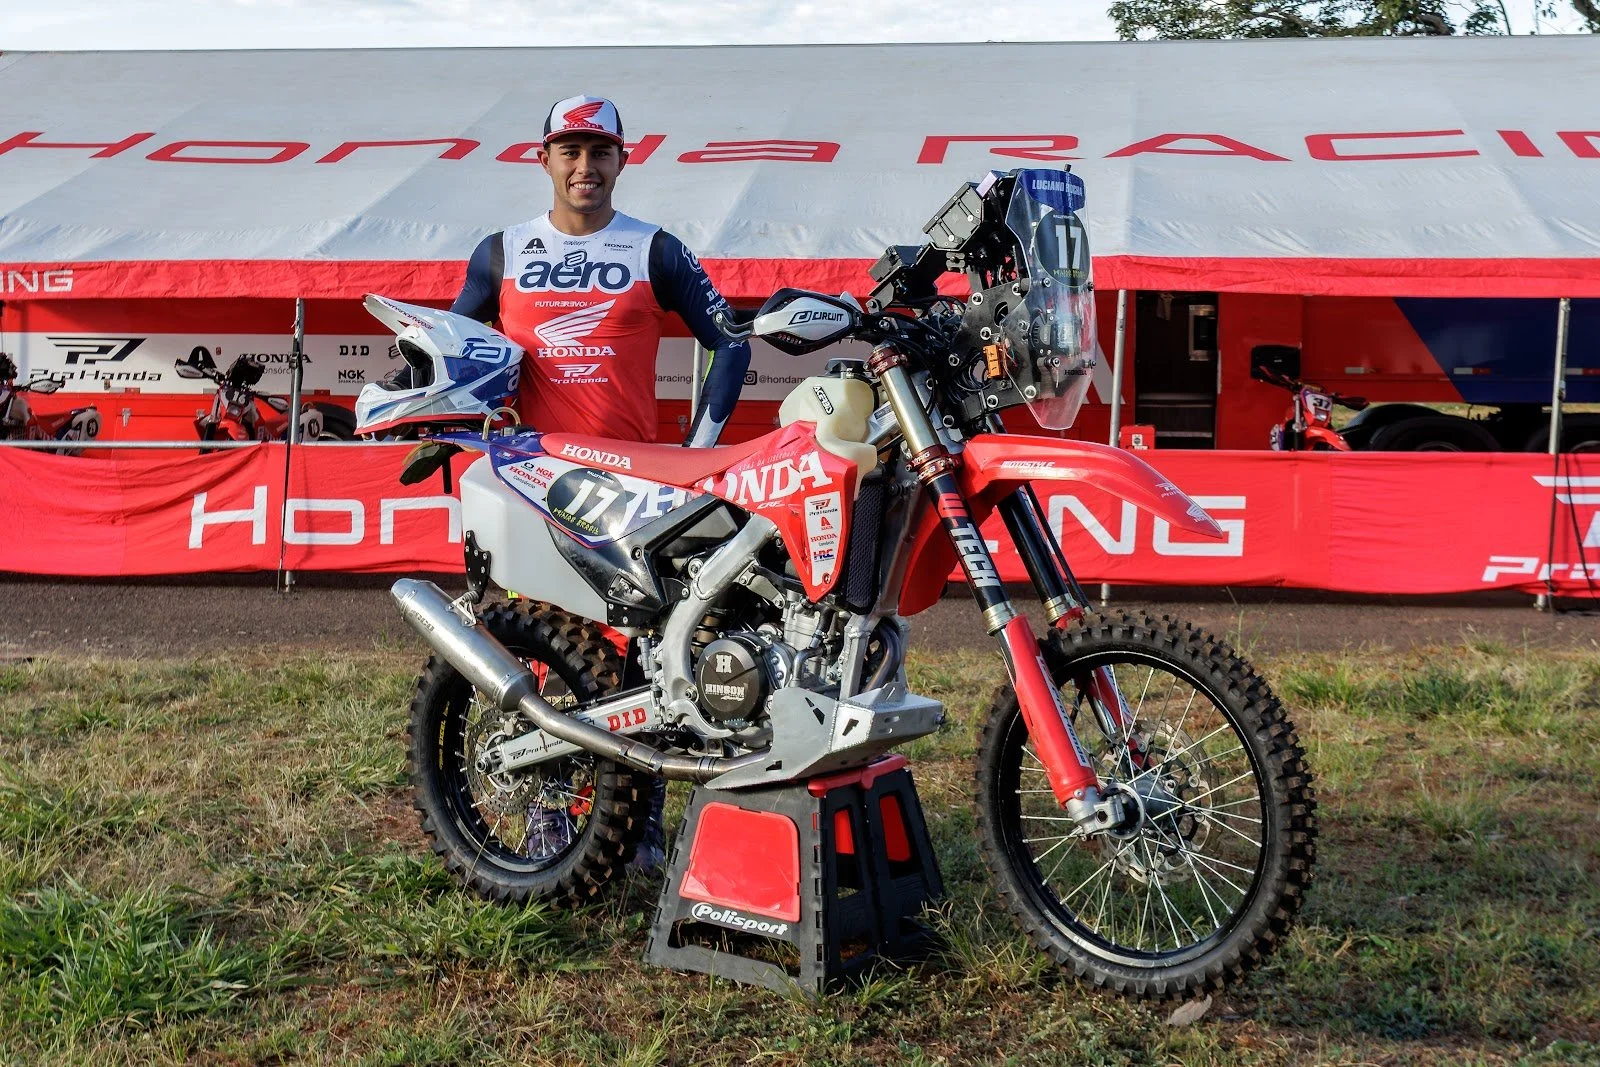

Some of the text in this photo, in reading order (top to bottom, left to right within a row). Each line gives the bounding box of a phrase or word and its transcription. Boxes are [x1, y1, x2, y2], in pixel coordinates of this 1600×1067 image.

[1032, 180, 1064, 191] LUCIANO
[1055, 225, 1082, 268] 17
[519, 261, 631, 289] aero
[811, 312, 845, 322] CIRCUIT
[240, 353, 312, 364] HONA
[537, 346, 617, 358] HONDA
[338, 369, 365, 380] NGK
[813, 386, 833, 415] ACERBIS
[560, 443, 632, 470] HONDA
[509, 466, 547, 489] HONDA
[536, 467, 555, 479] NGK
[562, 478, 620, 524] 17
[189, 486, 463, 550] Hon
[553, 507, 576, 523] MINAS
[811, 533, 837, 542] HONDA
[705, 683, 745, 696] HINSON
[691, 903, 788, 935] Polisport
